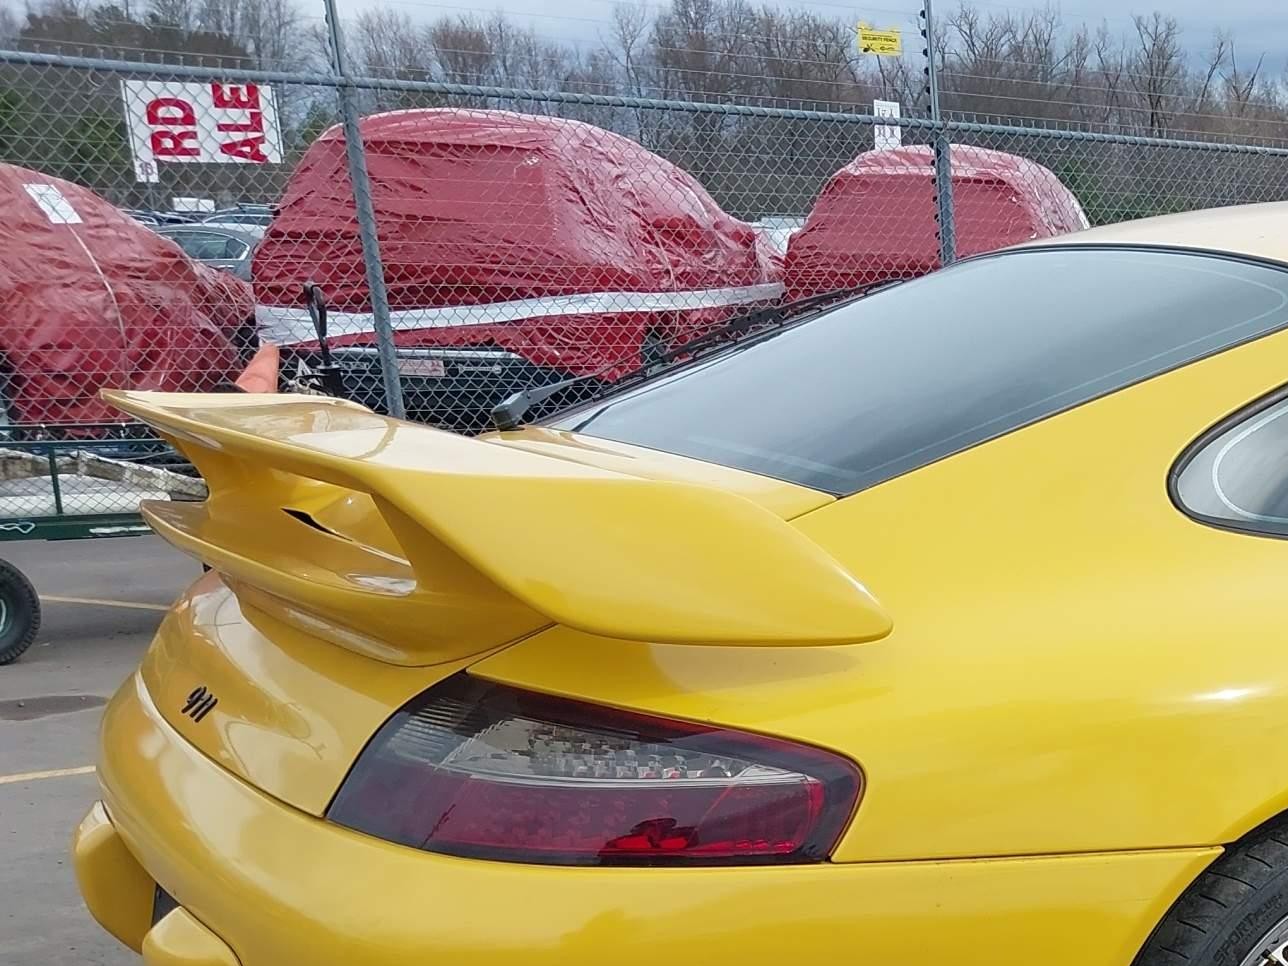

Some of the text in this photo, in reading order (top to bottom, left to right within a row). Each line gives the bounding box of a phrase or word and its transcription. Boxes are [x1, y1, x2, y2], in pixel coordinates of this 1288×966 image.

[146, 98, 201, 157] RD
[211, 83, 269, 164] ALE
[181, 686, 219, 723] 911
